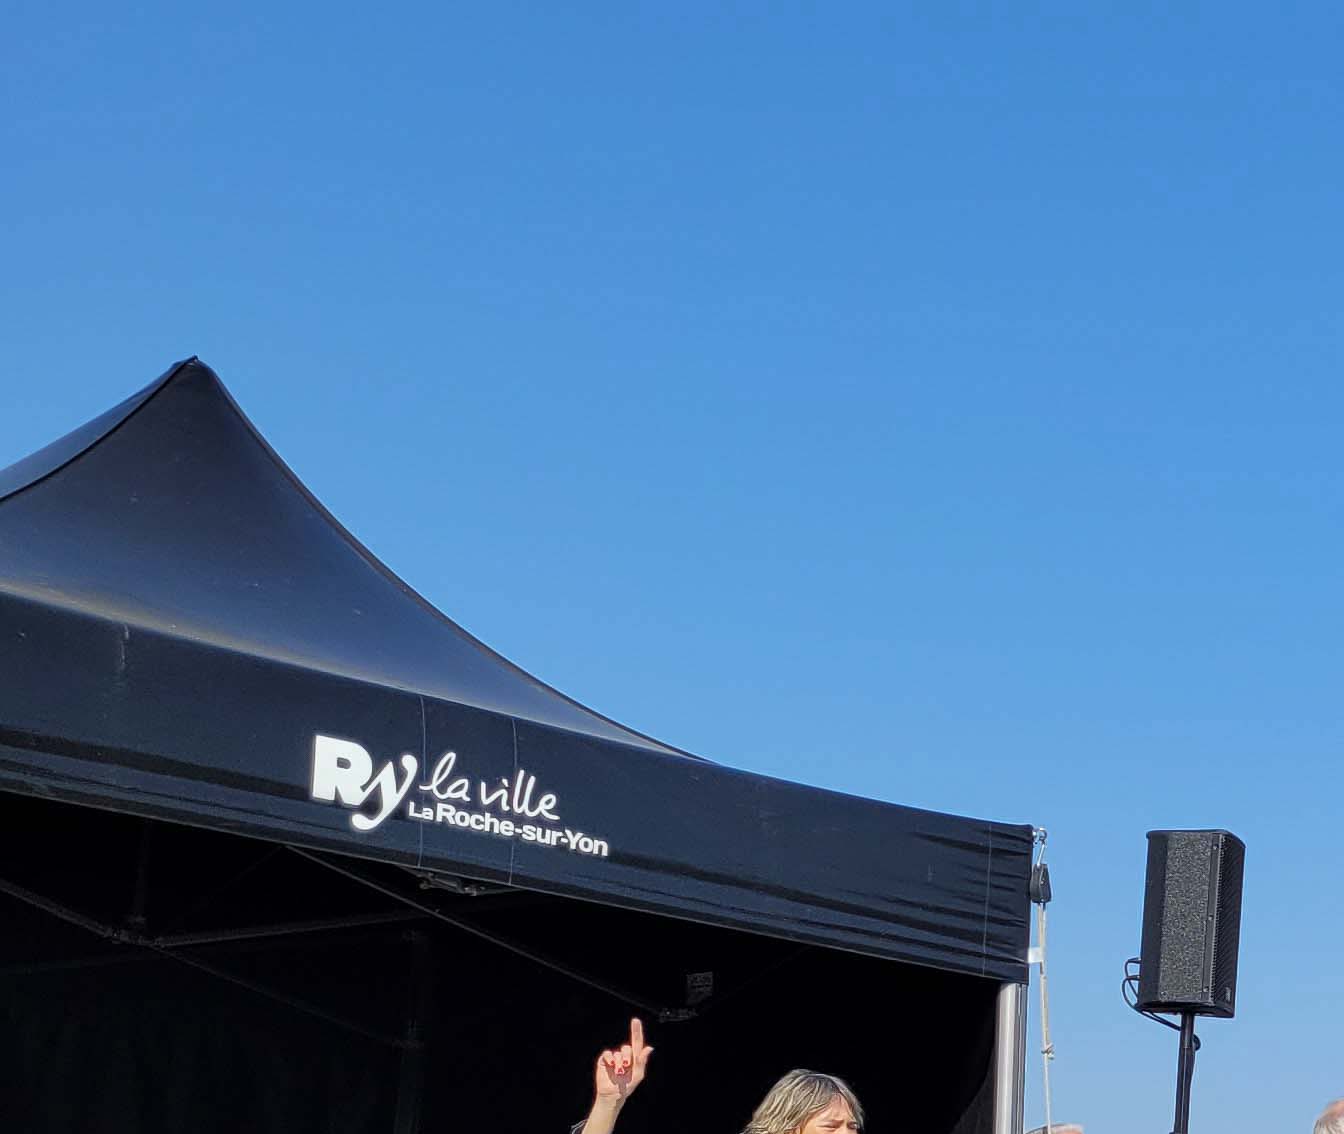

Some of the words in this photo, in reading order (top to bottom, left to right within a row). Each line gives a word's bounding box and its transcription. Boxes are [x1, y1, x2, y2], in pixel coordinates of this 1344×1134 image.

[420, 752, 471, 801] la
[480, 769, 560, 821] ville
[435, 804, 609, 857] Roche-sur-Yon
